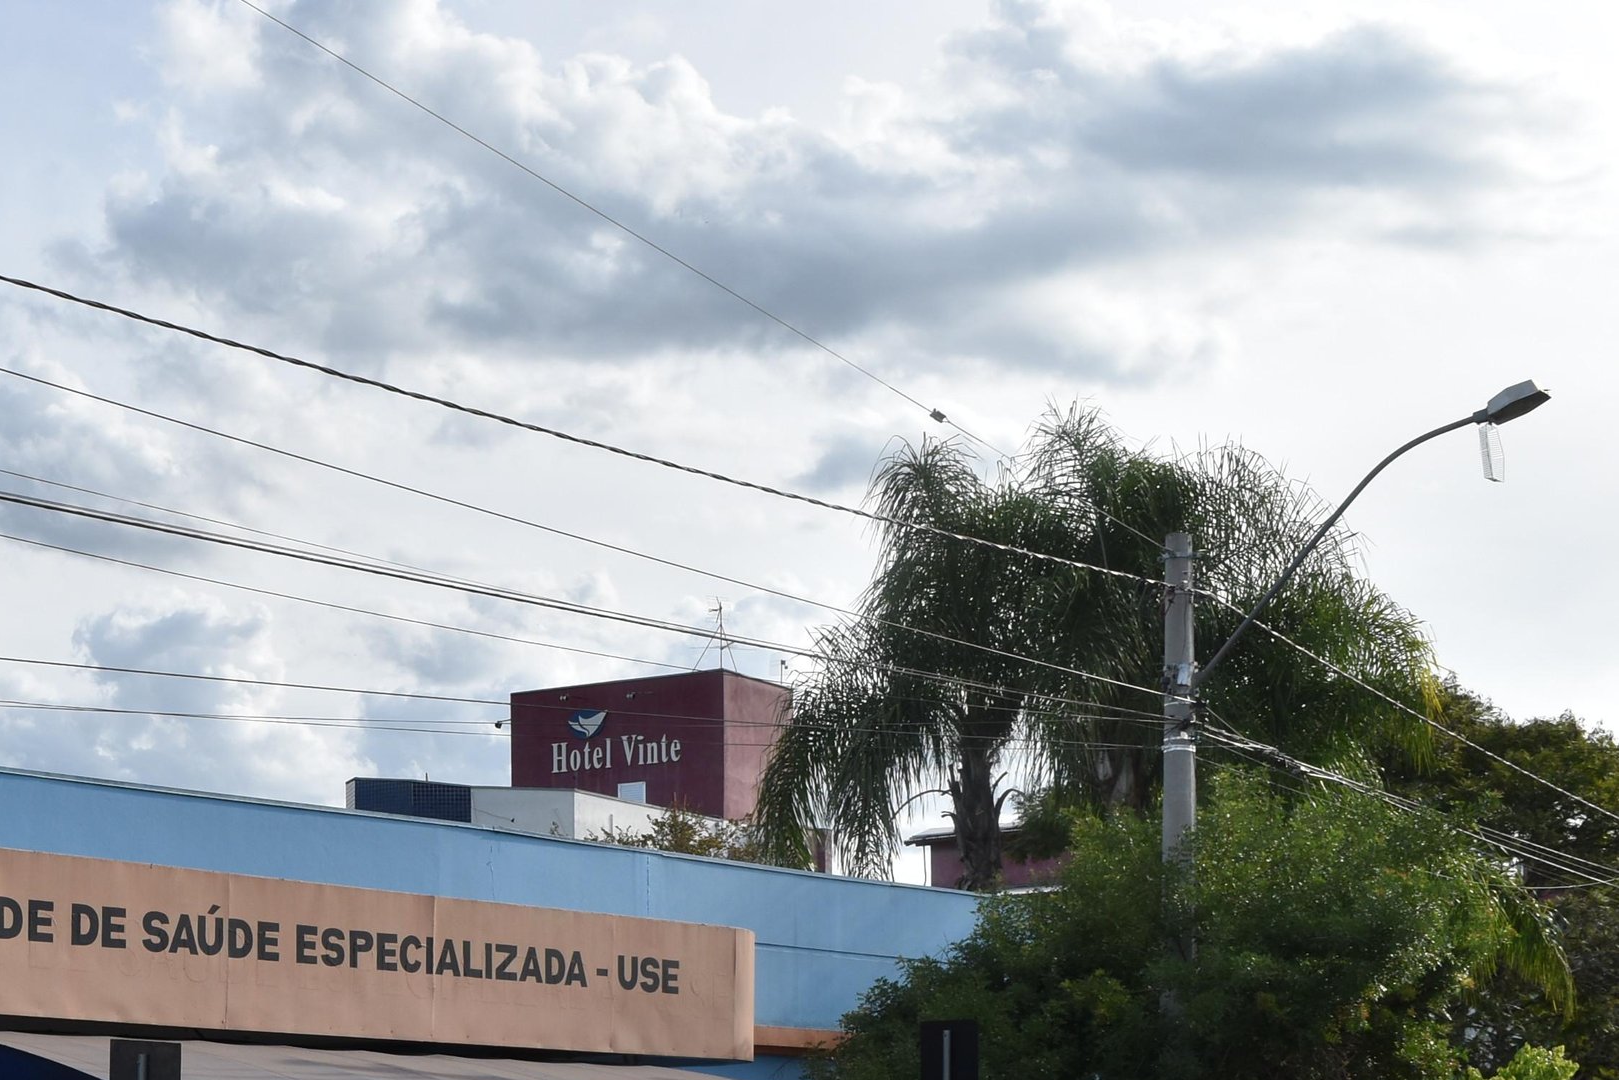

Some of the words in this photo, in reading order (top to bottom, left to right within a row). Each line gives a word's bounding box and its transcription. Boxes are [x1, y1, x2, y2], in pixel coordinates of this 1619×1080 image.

[551, 738, 611, 774] Hotel
[622, 733, 681, 766] Vinte
[71, 903, 127, 949] DE
[142, 905, 280, 961] SAÚDE
[296, 924, 588, 988] ESPECIALIZADA
[617, 955, 680, 995] USE
